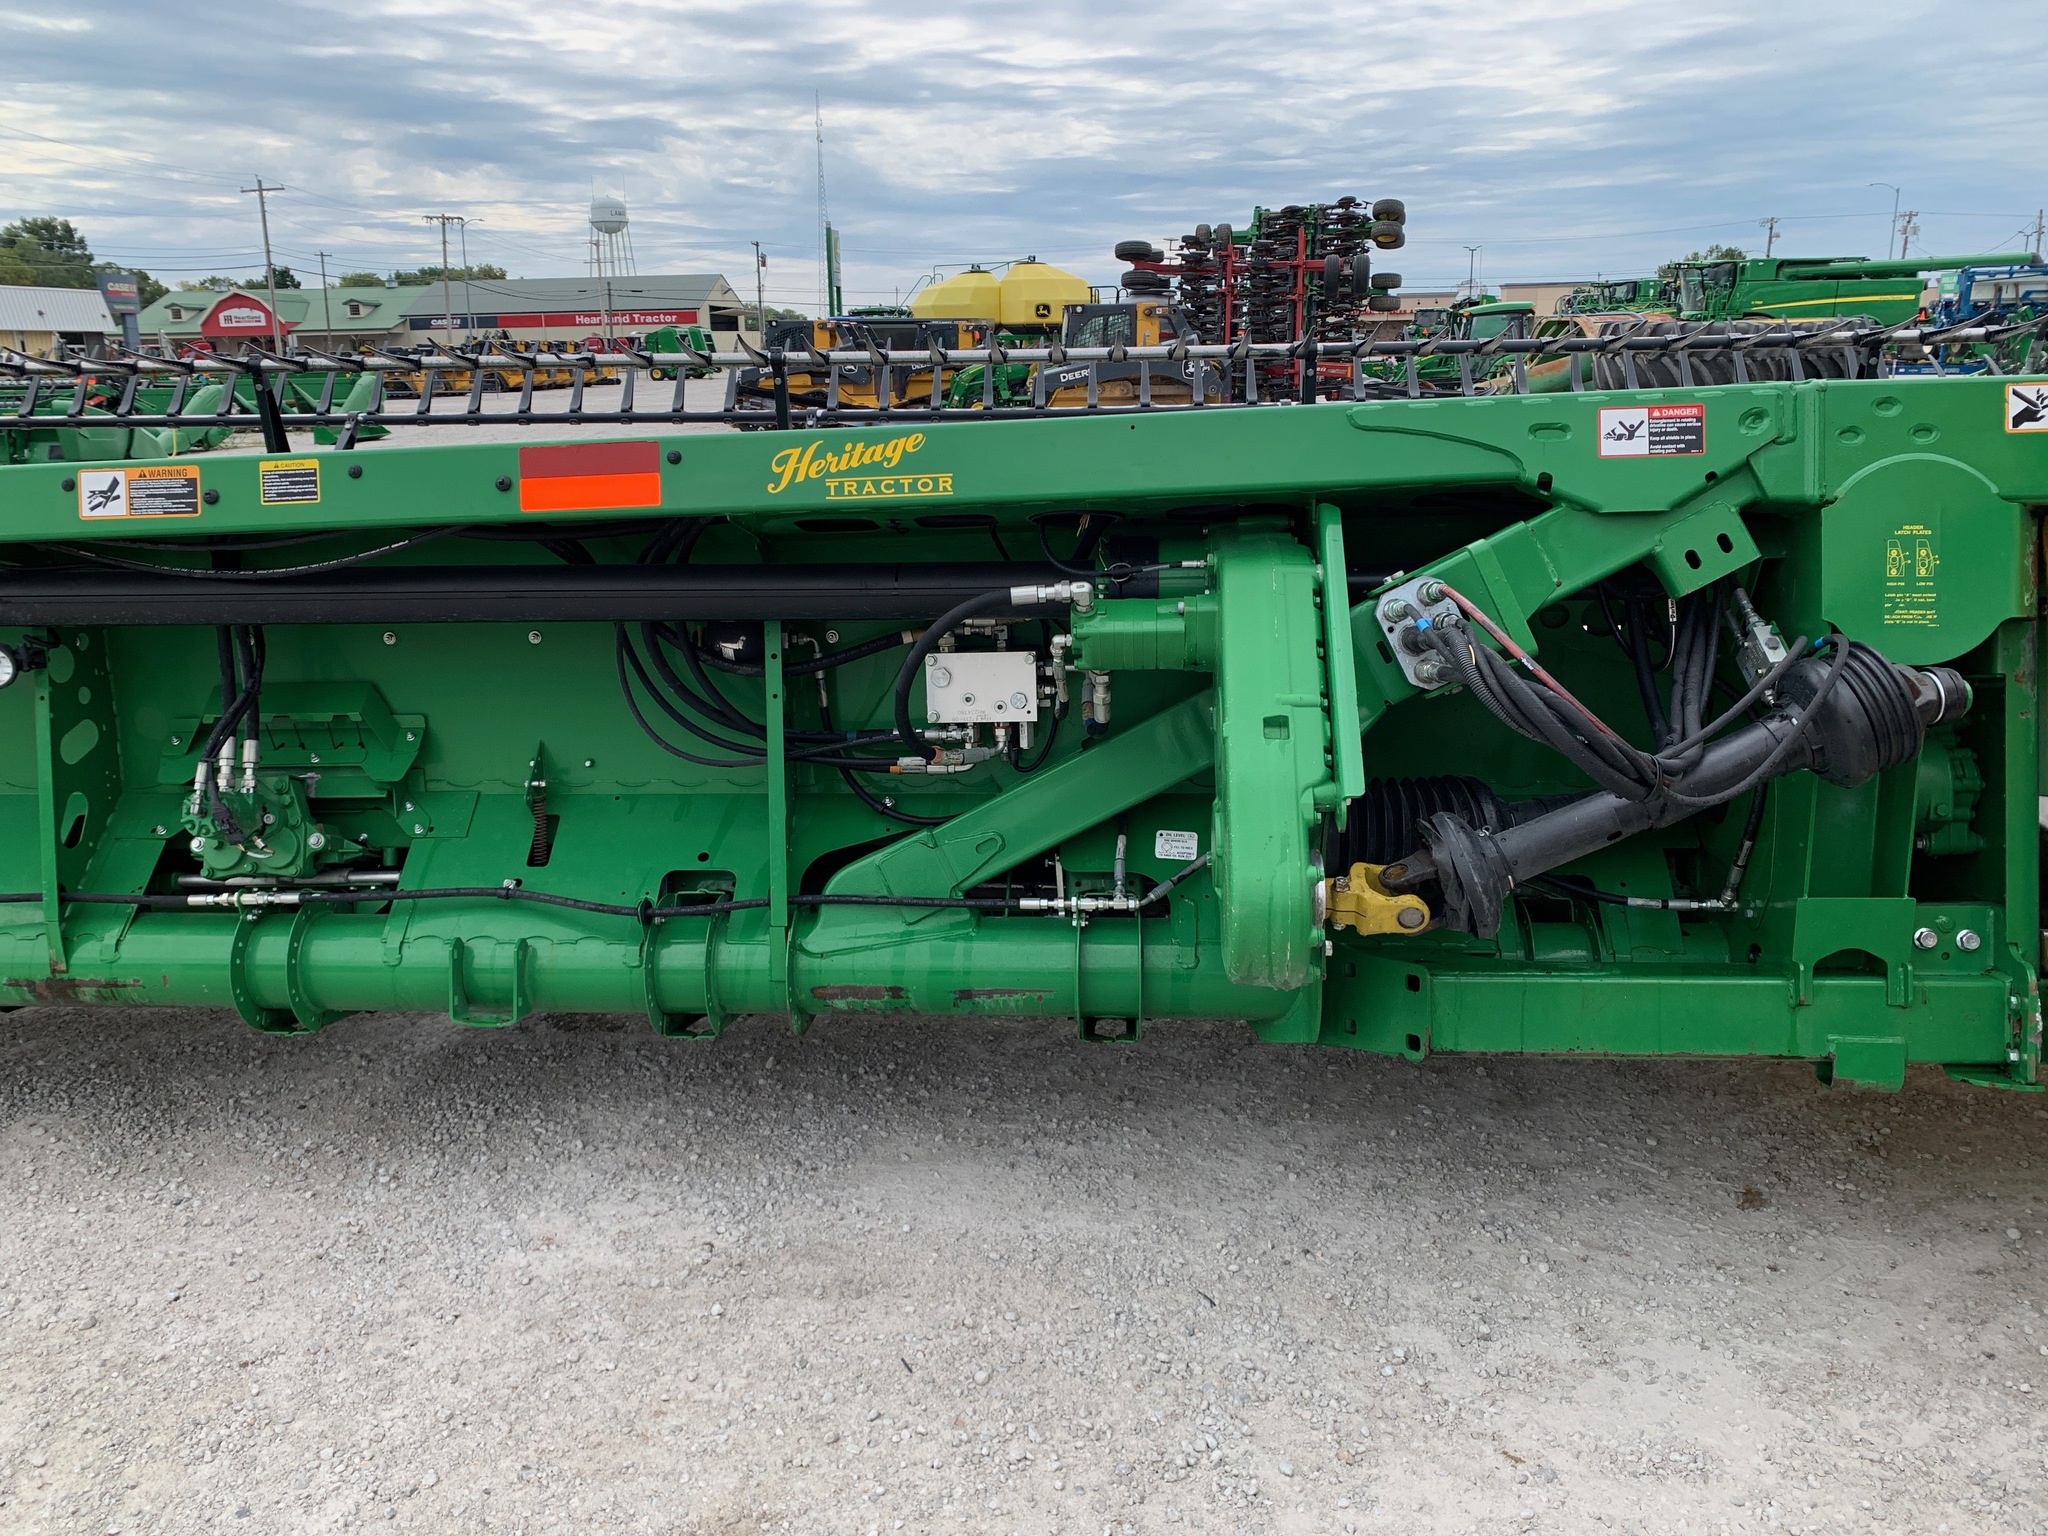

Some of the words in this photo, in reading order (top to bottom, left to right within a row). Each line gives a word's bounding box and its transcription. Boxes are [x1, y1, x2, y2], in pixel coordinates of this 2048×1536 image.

[632, 314, 677, 323] Tractor
[1060, 368, 1090, 382] DEER
[1662, 408, 1698, 416] DANGER
[768, 433, 926, 494] Heritage
[148, 469, 188, 478] WARNING
[826, 478, 952, 496] TRACTOR
